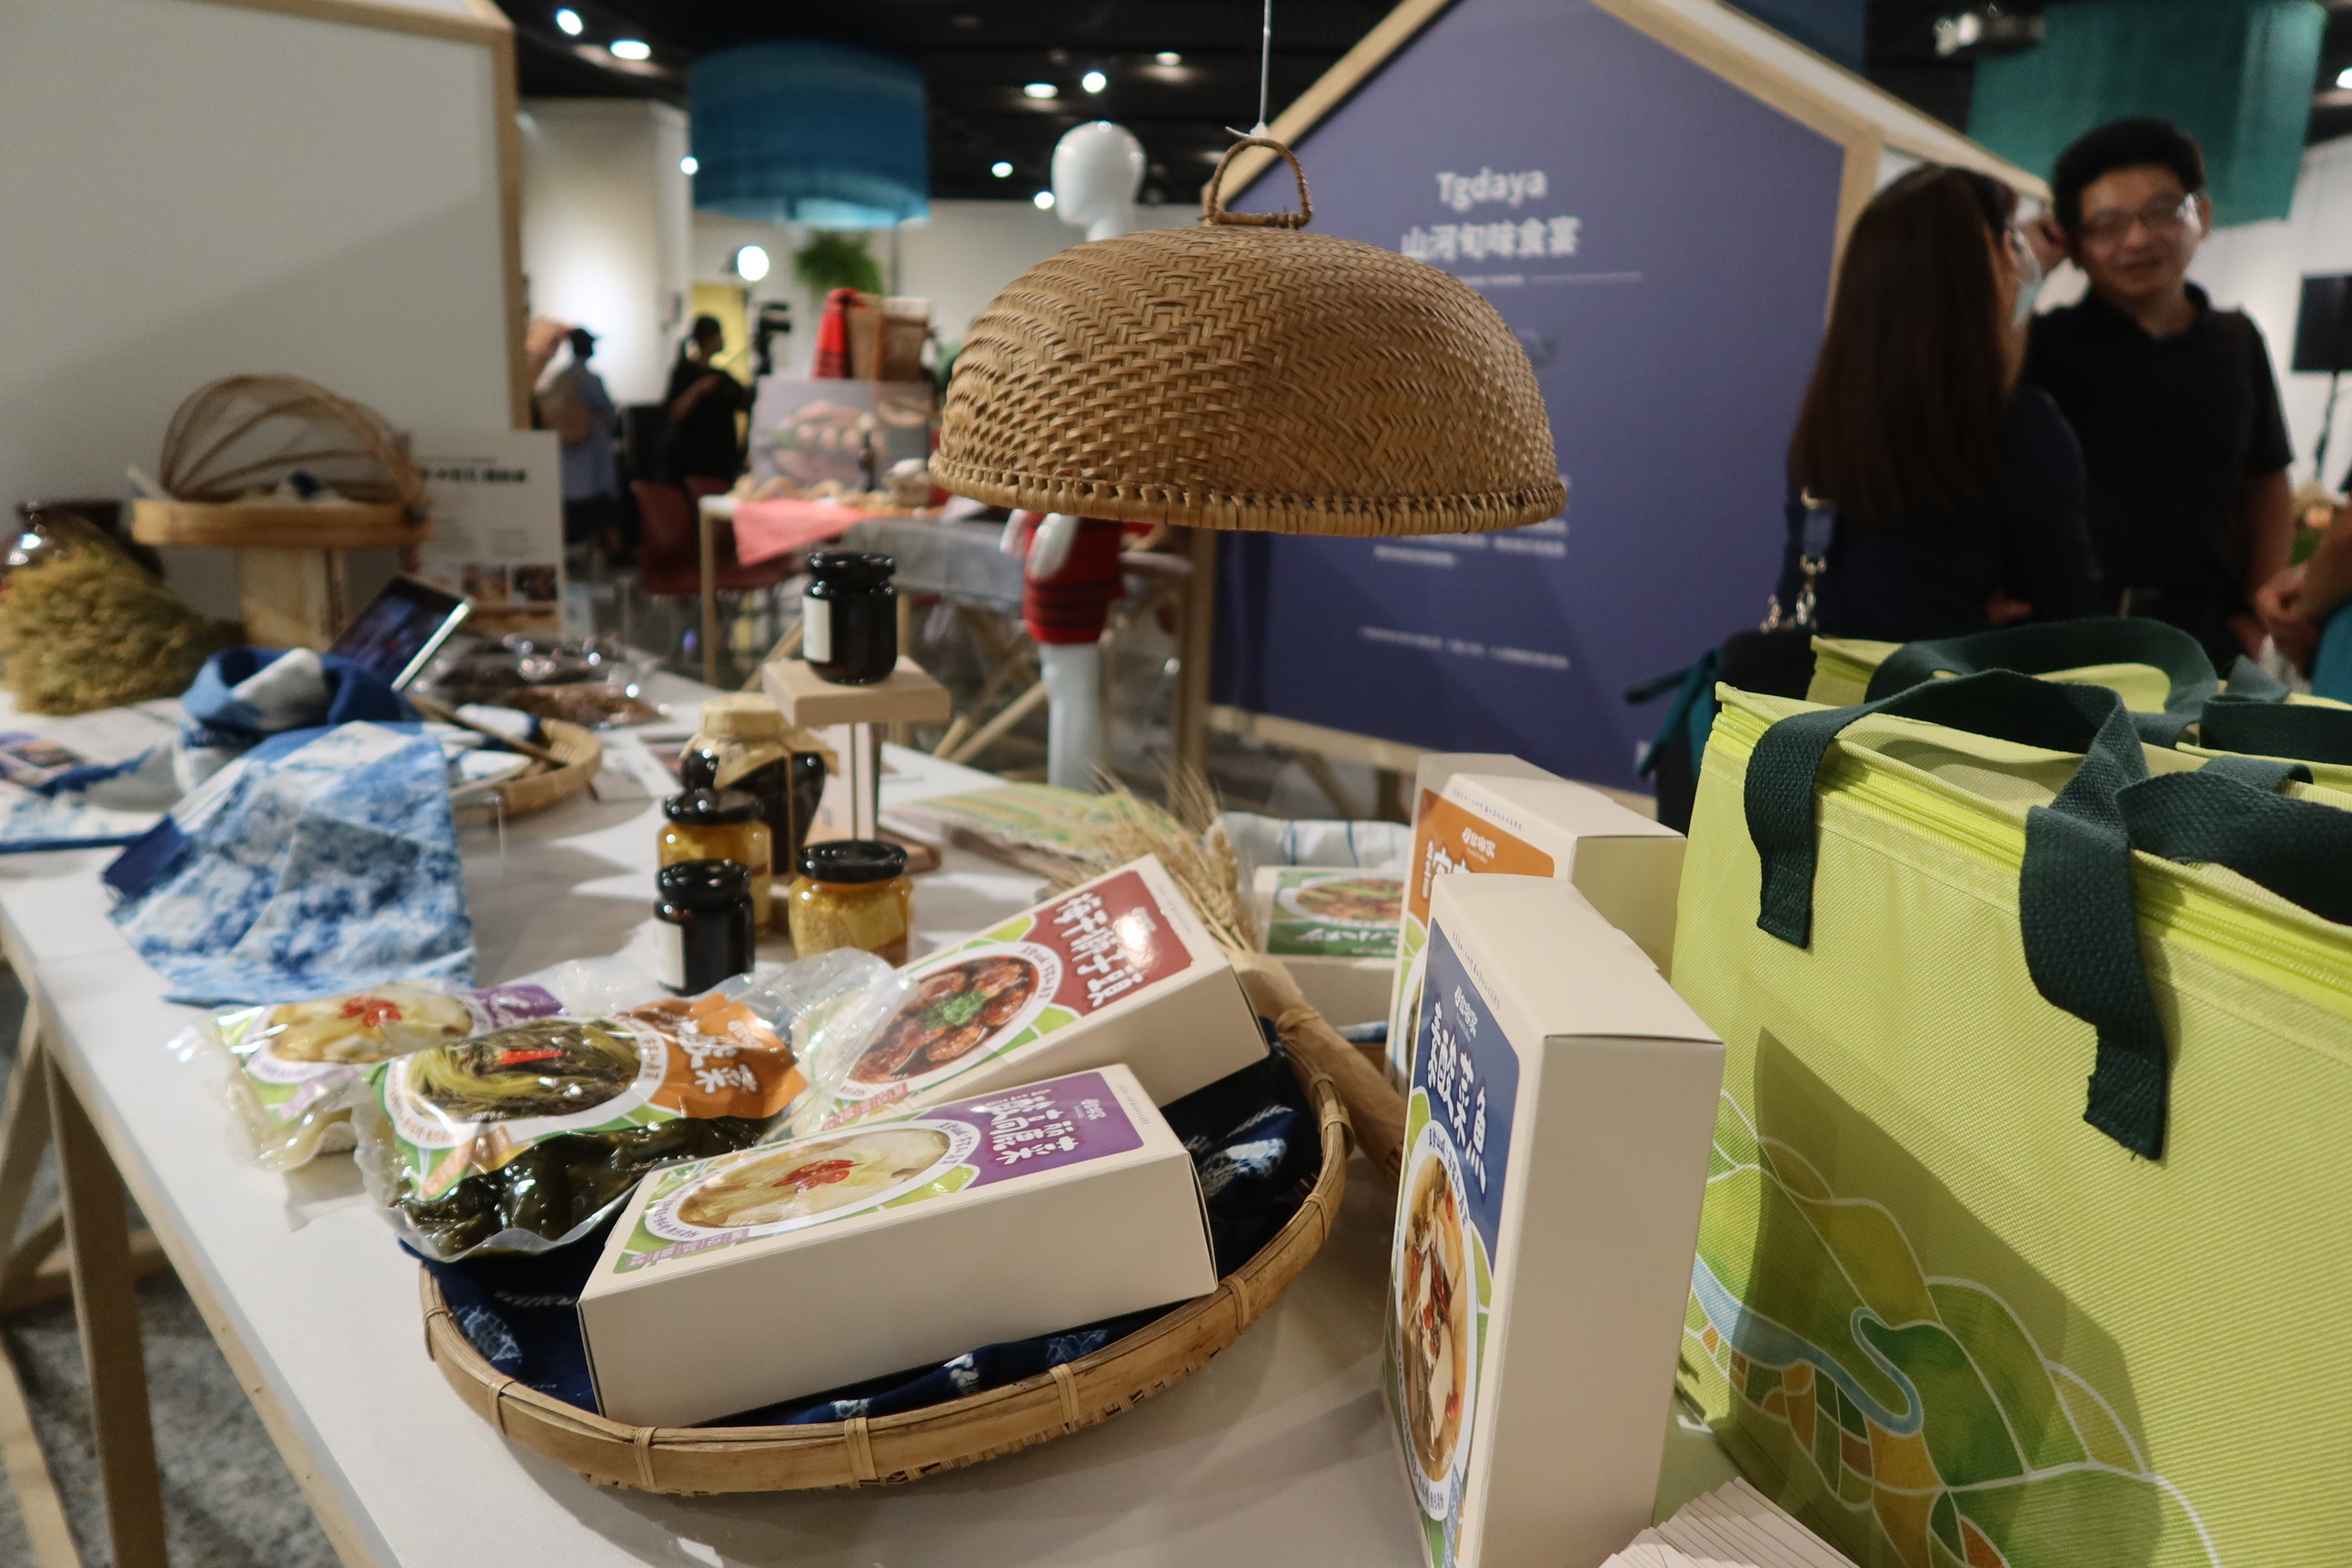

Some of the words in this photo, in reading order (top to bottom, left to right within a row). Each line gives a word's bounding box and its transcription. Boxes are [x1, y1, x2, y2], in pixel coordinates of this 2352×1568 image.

[1435, 166, 1548, 213] Tgdaya
[1052, 891, 1144, 1009] 梅干獅子頭
[989, 1095, 1080, 1165] 酸高麗菜
